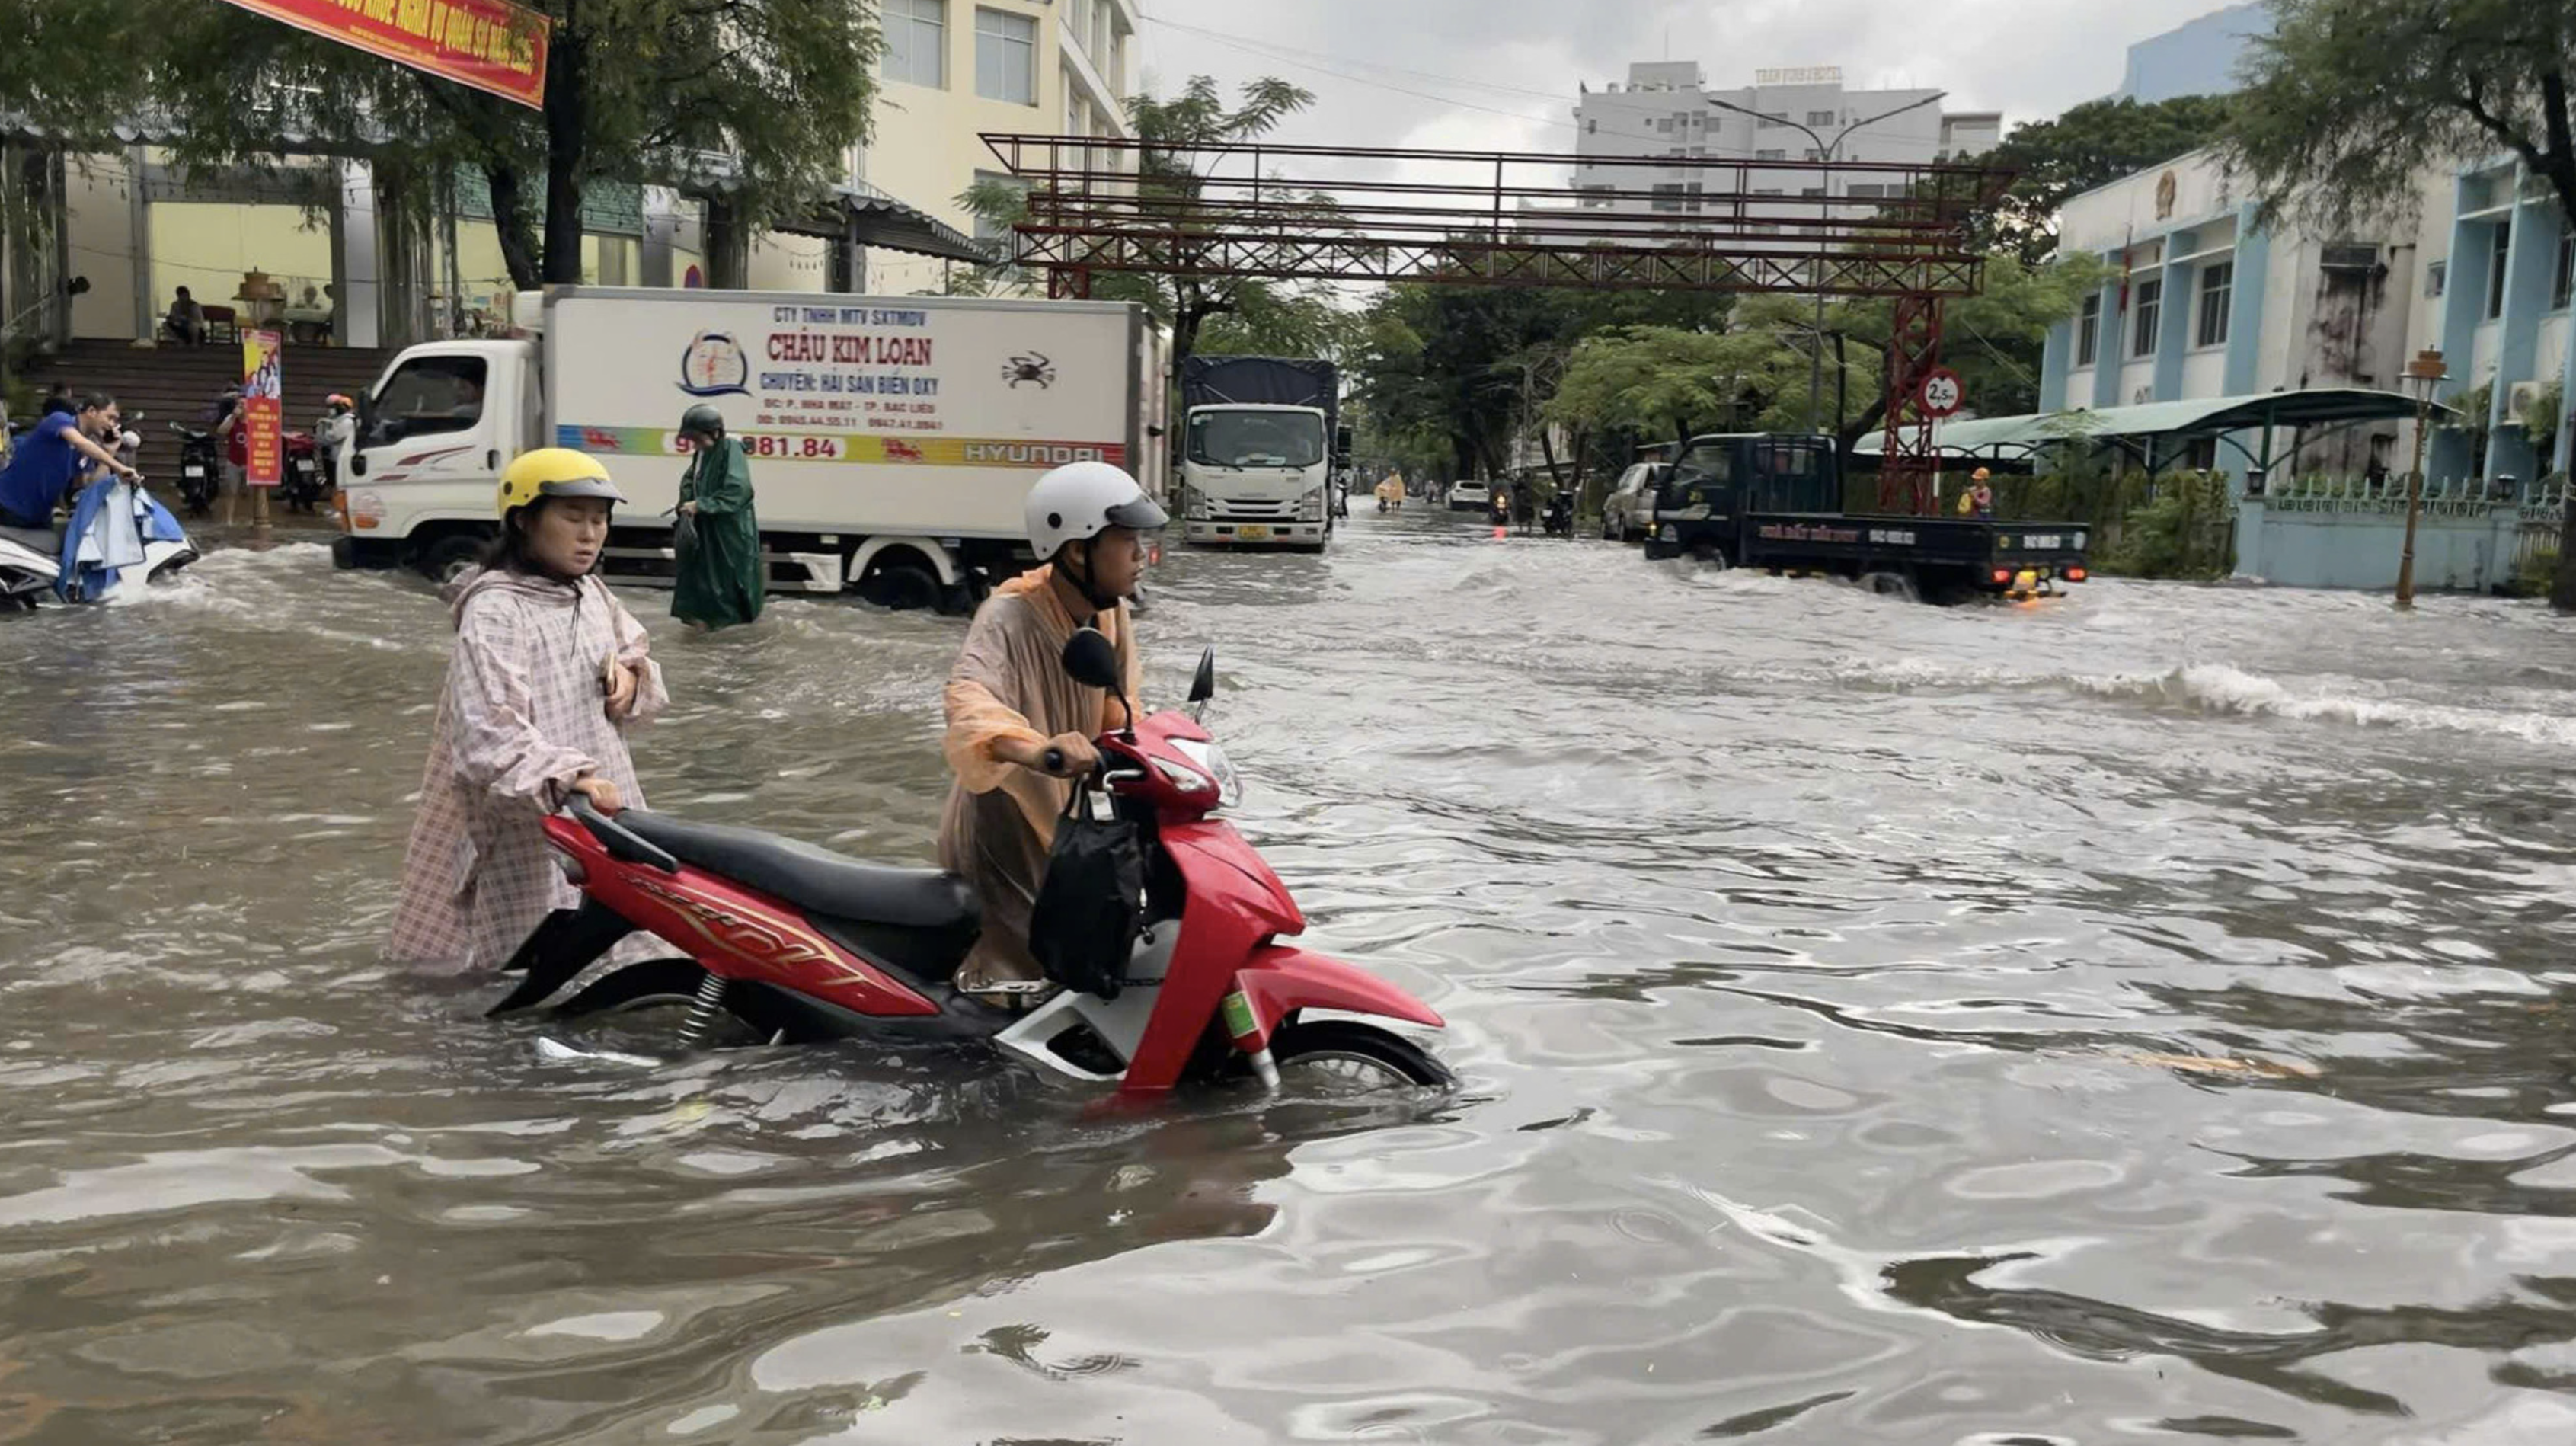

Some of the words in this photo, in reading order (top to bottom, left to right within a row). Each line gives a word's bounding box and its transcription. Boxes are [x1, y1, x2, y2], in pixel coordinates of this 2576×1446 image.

[774, 306, 797, 323] CTY
[802, 307, 836, 324] TNHH
[840, 309, 868, 325] MTV
[833, 335, 871, 364] KIM
[877, 336, 932, 366] LOAN
[965, 444, 1105, 464] HYUNDAI
